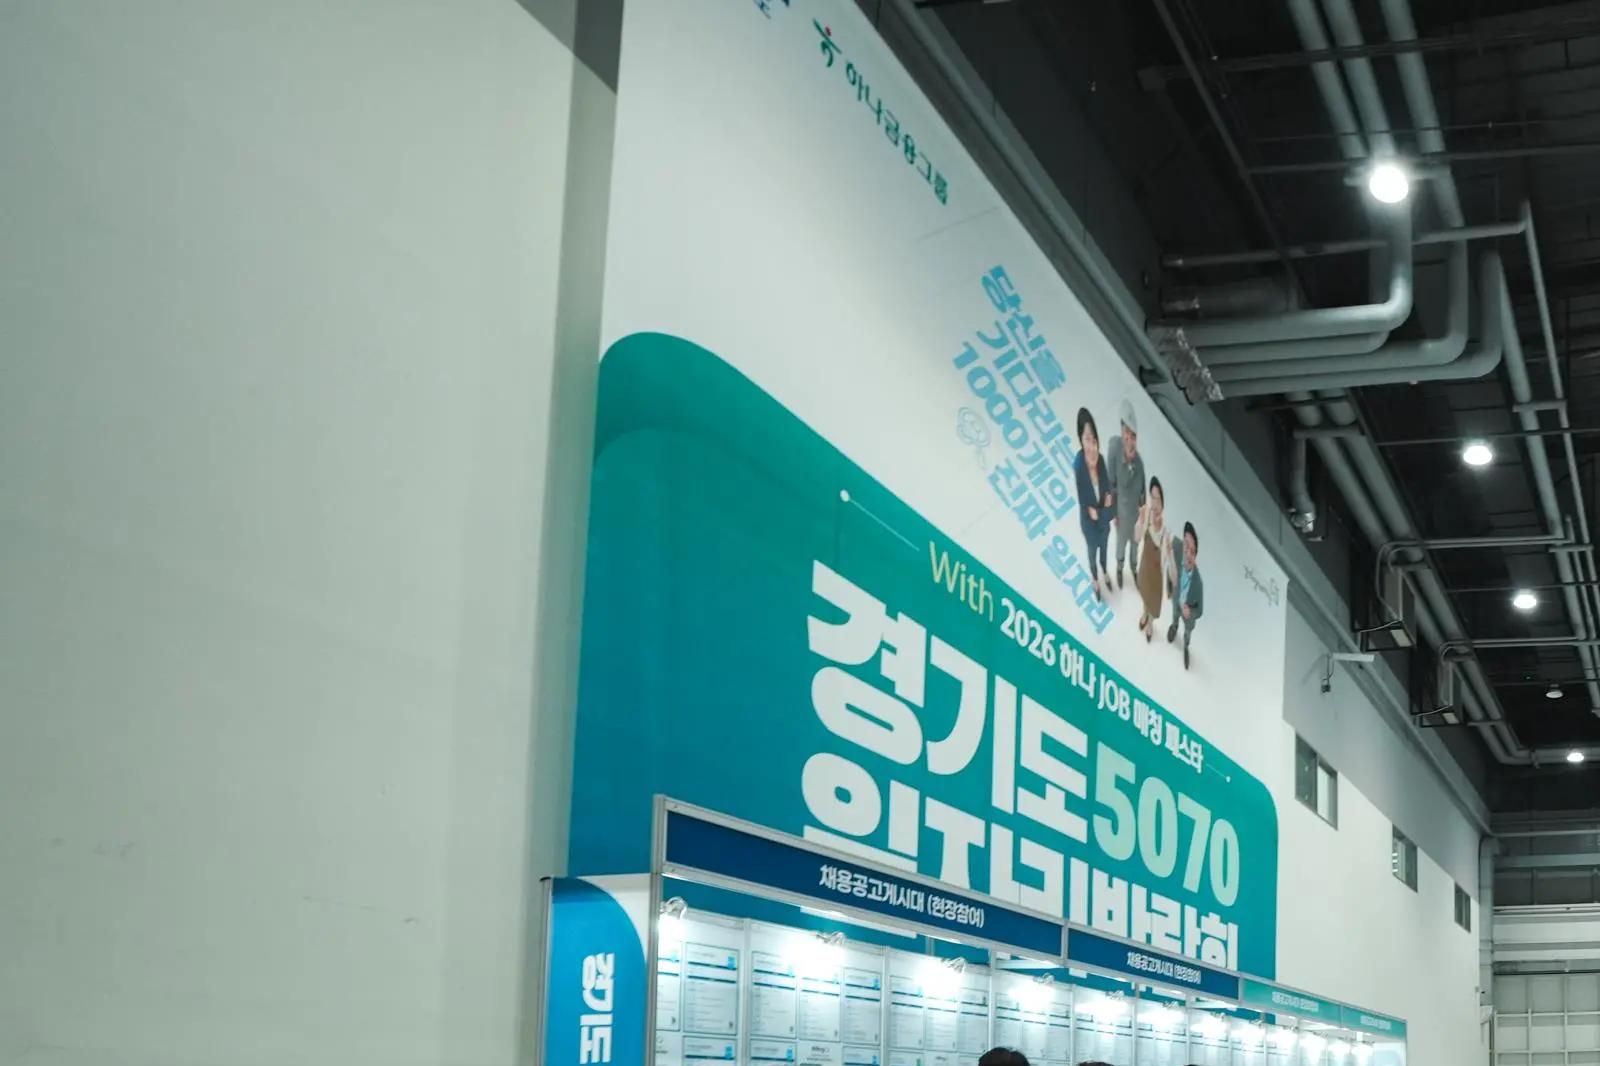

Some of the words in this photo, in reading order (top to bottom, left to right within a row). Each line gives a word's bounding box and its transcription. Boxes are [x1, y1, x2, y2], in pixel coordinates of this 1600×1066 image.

[846, 62, 948, 205] 하나금융그룹
[981, 265, 1067, 392] 당신을
[953, 341, 1078, 521] 1000개의
[976, 320, 1077, 481] 기다리는
[929, 541, 994, 622] With
[1000, 598, 1056, 667] 2026
[1059, 641, 1097, 699] 하나
[1097, 673, 1131, 722] JOB
[1132, 699, 1164, 746] 매칭
[1165, 720, 1205, 773] 페스타
[1040, 535, 1116, 636] 일자리
[818, 863, 925, 913] 채용공고게시대
[927, 893, 985, 928] (현장참여)
